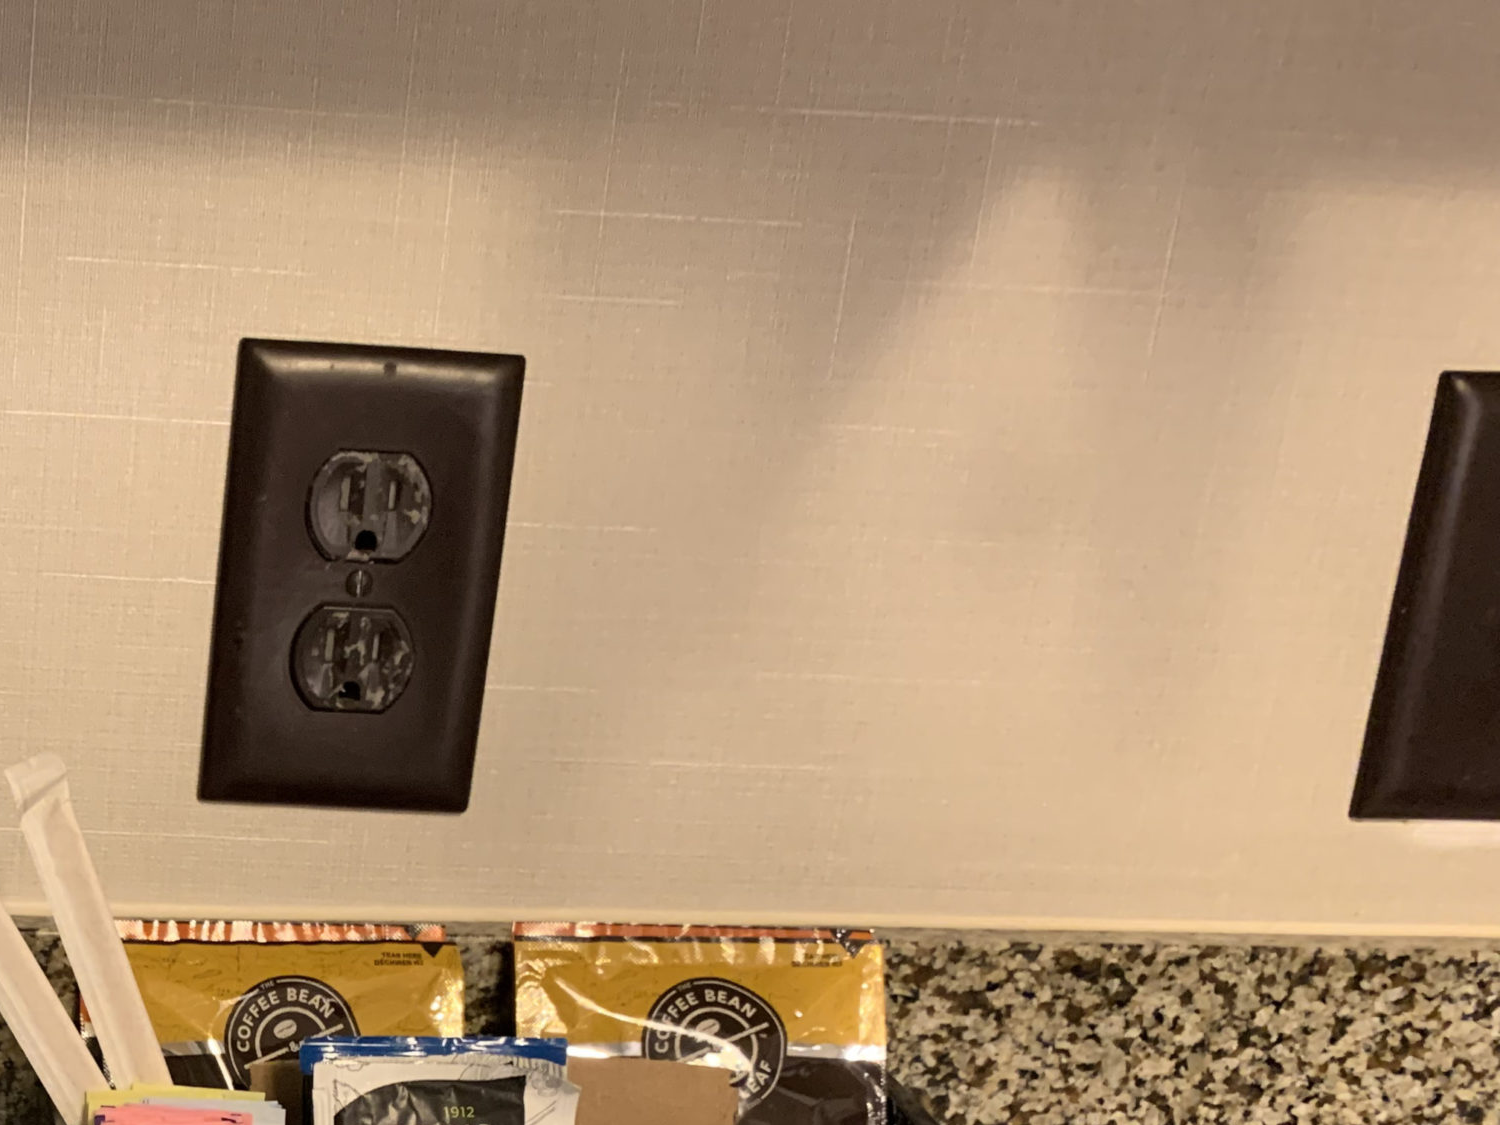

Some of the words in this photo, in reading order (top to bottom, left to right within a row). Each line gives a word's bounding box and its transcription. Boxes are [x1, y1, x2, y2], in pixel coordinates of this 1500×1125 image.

[260, 980, 275, 991] THE
[704, 988, 757, 1019] BEAN
[236, 990, 280, 1053] COFFEE
[286, 986, 336, 1019] BEAN
[443, 1105, 475, 1119] 1912
